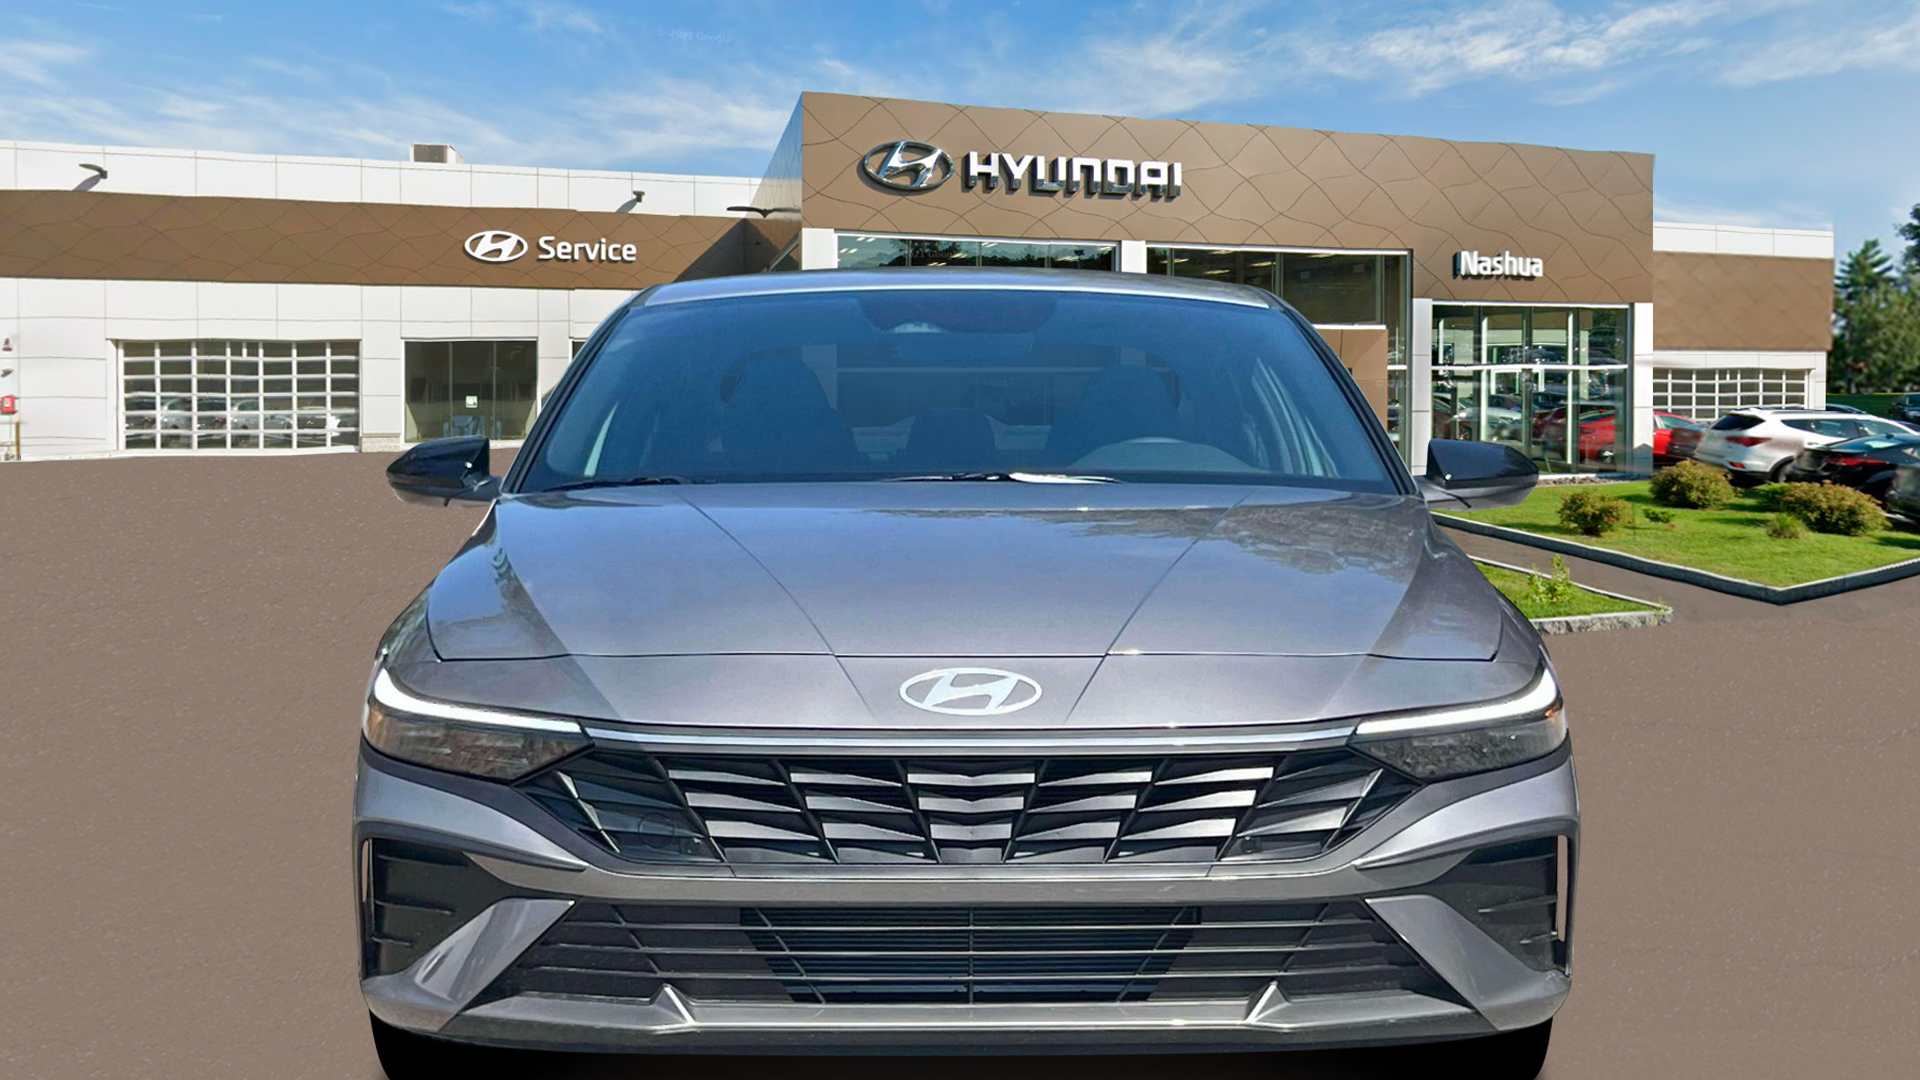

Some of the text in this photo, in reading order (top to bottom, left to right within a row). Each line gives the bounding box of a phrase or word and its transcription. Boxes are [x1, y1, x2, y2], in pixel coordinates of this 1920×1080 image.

[967, 151, 1182, 198] HYUNDAI
[538, 235, 637, 262] Service
[1460, 250, 1544, 277] Nashua
